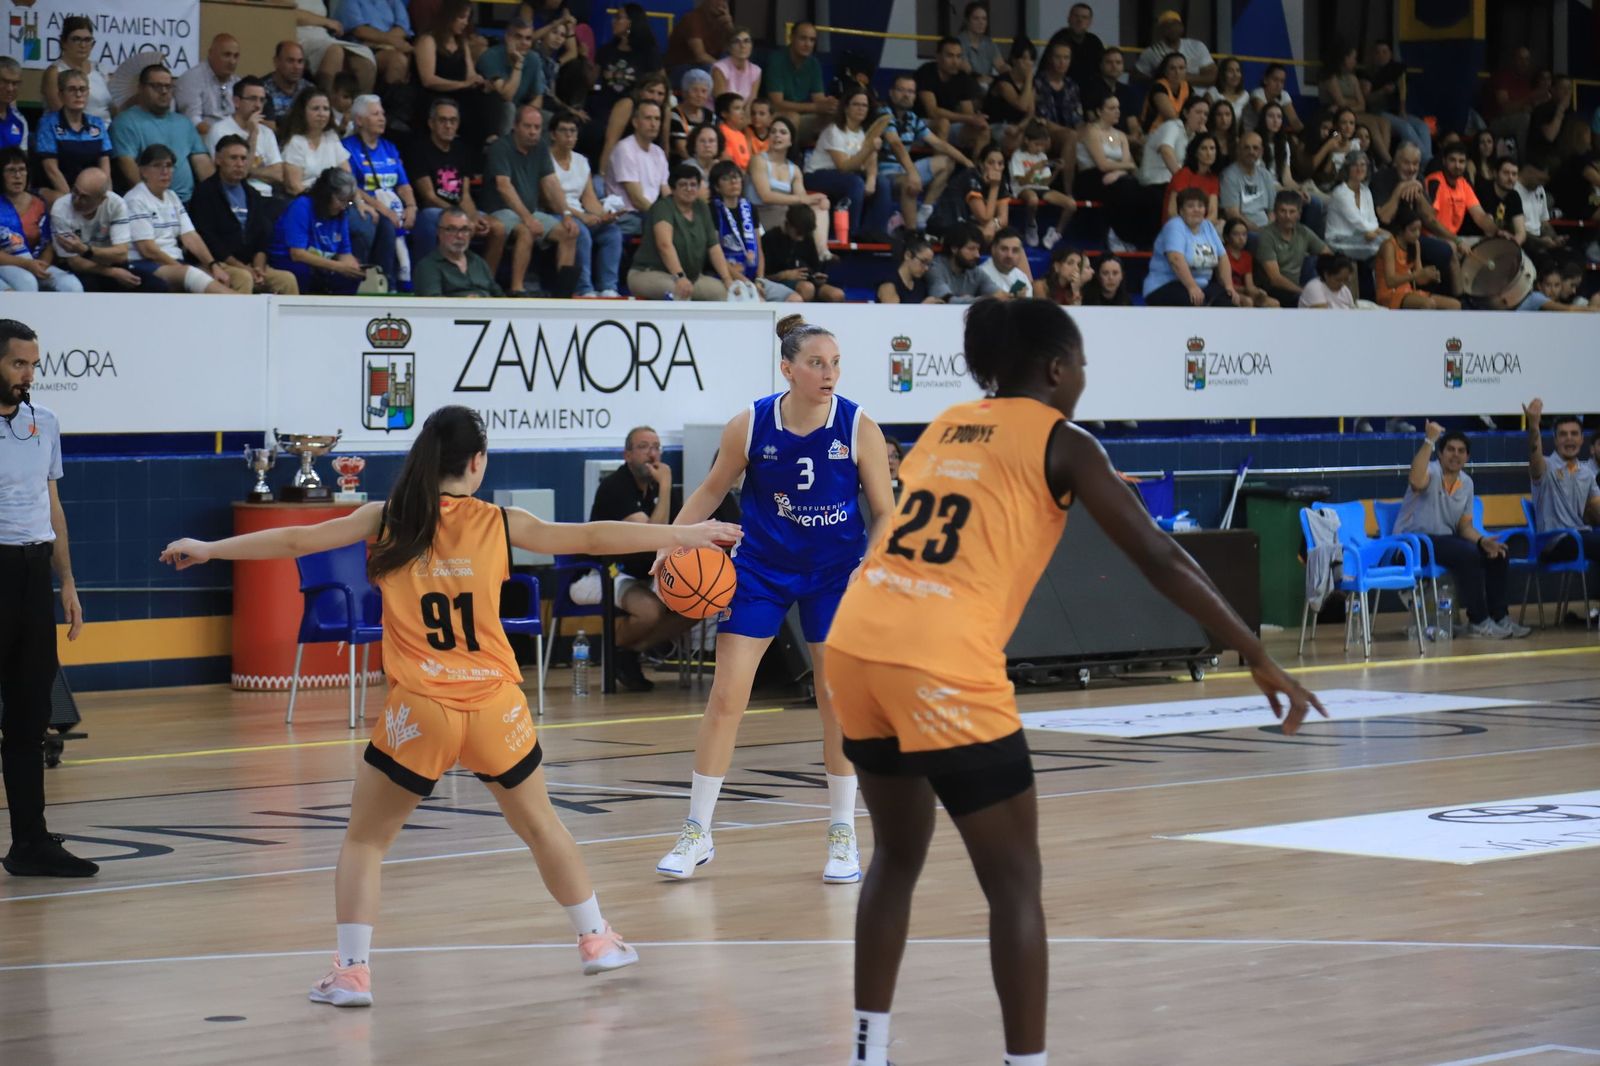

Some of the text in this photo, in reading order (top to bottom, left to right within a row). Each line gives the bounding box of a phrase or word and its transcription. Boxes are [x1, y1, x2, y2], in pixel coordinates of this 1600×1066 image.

[47, 11, 191, 39] ANTAMIENTO
[36, 349, 118, 378] MORA
[453, 319, 704, 394] ZAMORA
[916, 352, 967, 377] ZAMO
[1208, 352, 1272, 375] ZAMORA
[1465, 352, 1522, 375] ZAMORA
[474, 408, 612, 429] UNTAMIENTO
[796, 457, 815, 490] 3
[886, 488, 972, 565] 23
[420, 592, 481, 652] 91
